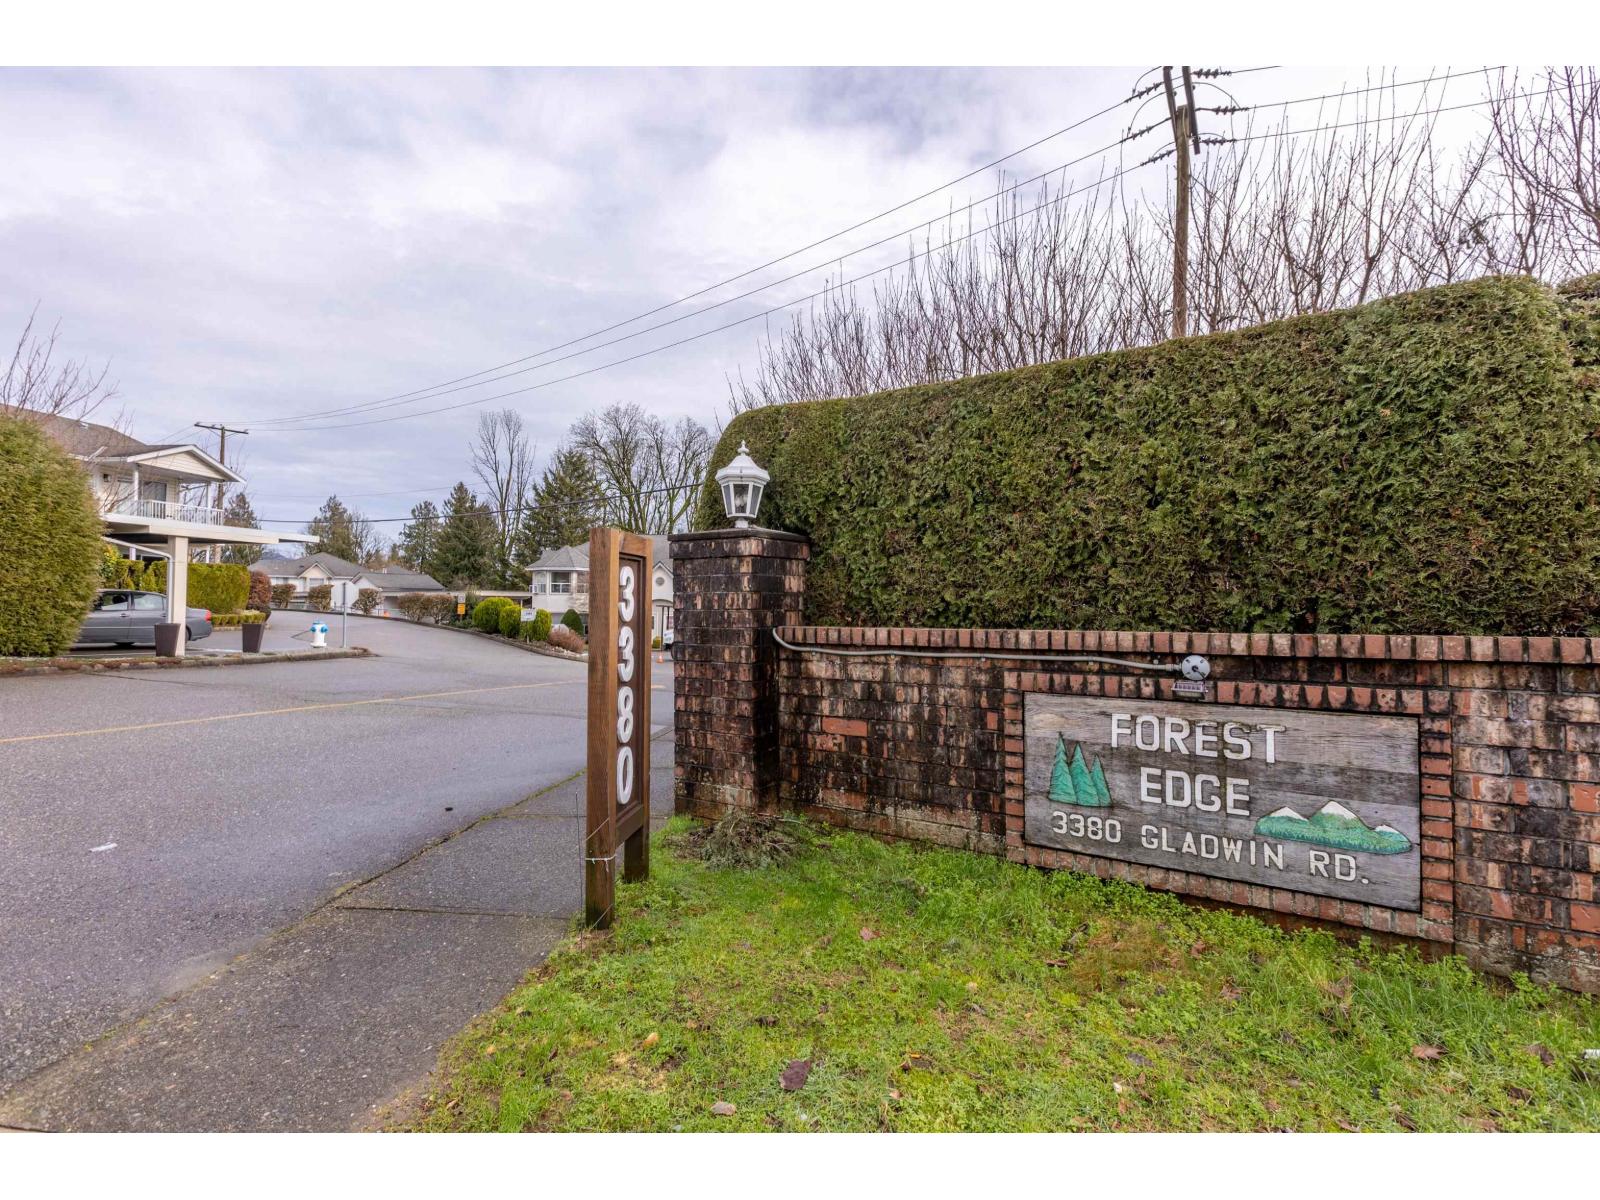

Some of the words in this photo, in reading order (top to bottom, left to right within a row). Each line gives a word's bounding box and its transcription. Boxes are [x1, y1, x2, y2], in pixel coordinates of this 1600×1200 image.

[617, 565, 635, 804] 3380
[1111, 713, 1286, 764] FOREST
[1140, 766, 1251, 816] EDGE
[1052, 810, 1122, 843] 3380
[1141, 824, 1284, 871] GLADWIN
[1309, 850, 1370, 884] RD.
